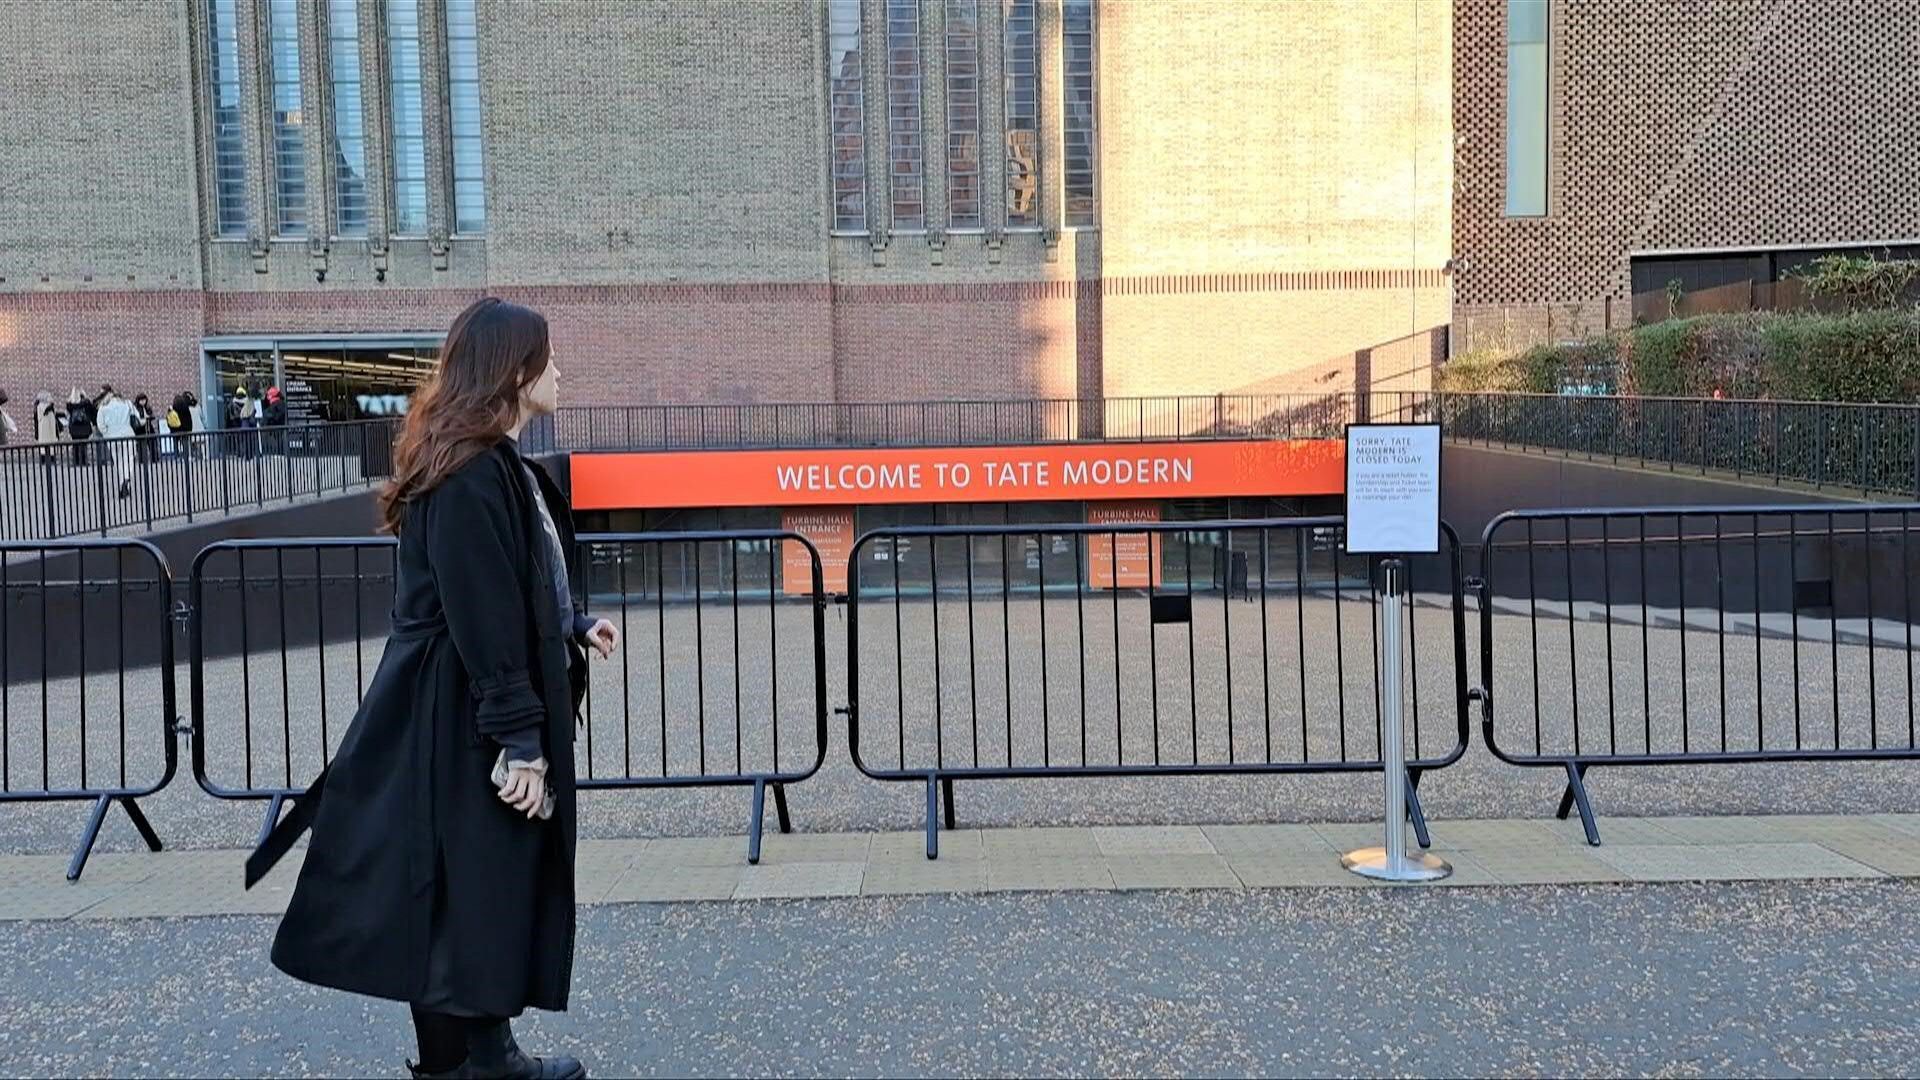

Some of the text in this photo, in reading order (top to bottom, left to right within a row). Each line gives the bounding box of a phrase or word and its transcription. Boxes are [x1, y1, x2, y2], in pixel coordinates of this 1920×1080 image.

[1355, 437, 1411, 446] SORRY, TATE
[1356, 447, 1407, 455] MODERN IS
[1356, 456, 1389, 464] CLOSED
[776, 457, 1193, 490] WELCOME TO TATE MODERN
[1133, 510, 1156, 518] HALL
[827, 515, 850, 524] HALL
[794, 525, 842, 533] ENTRANCE
